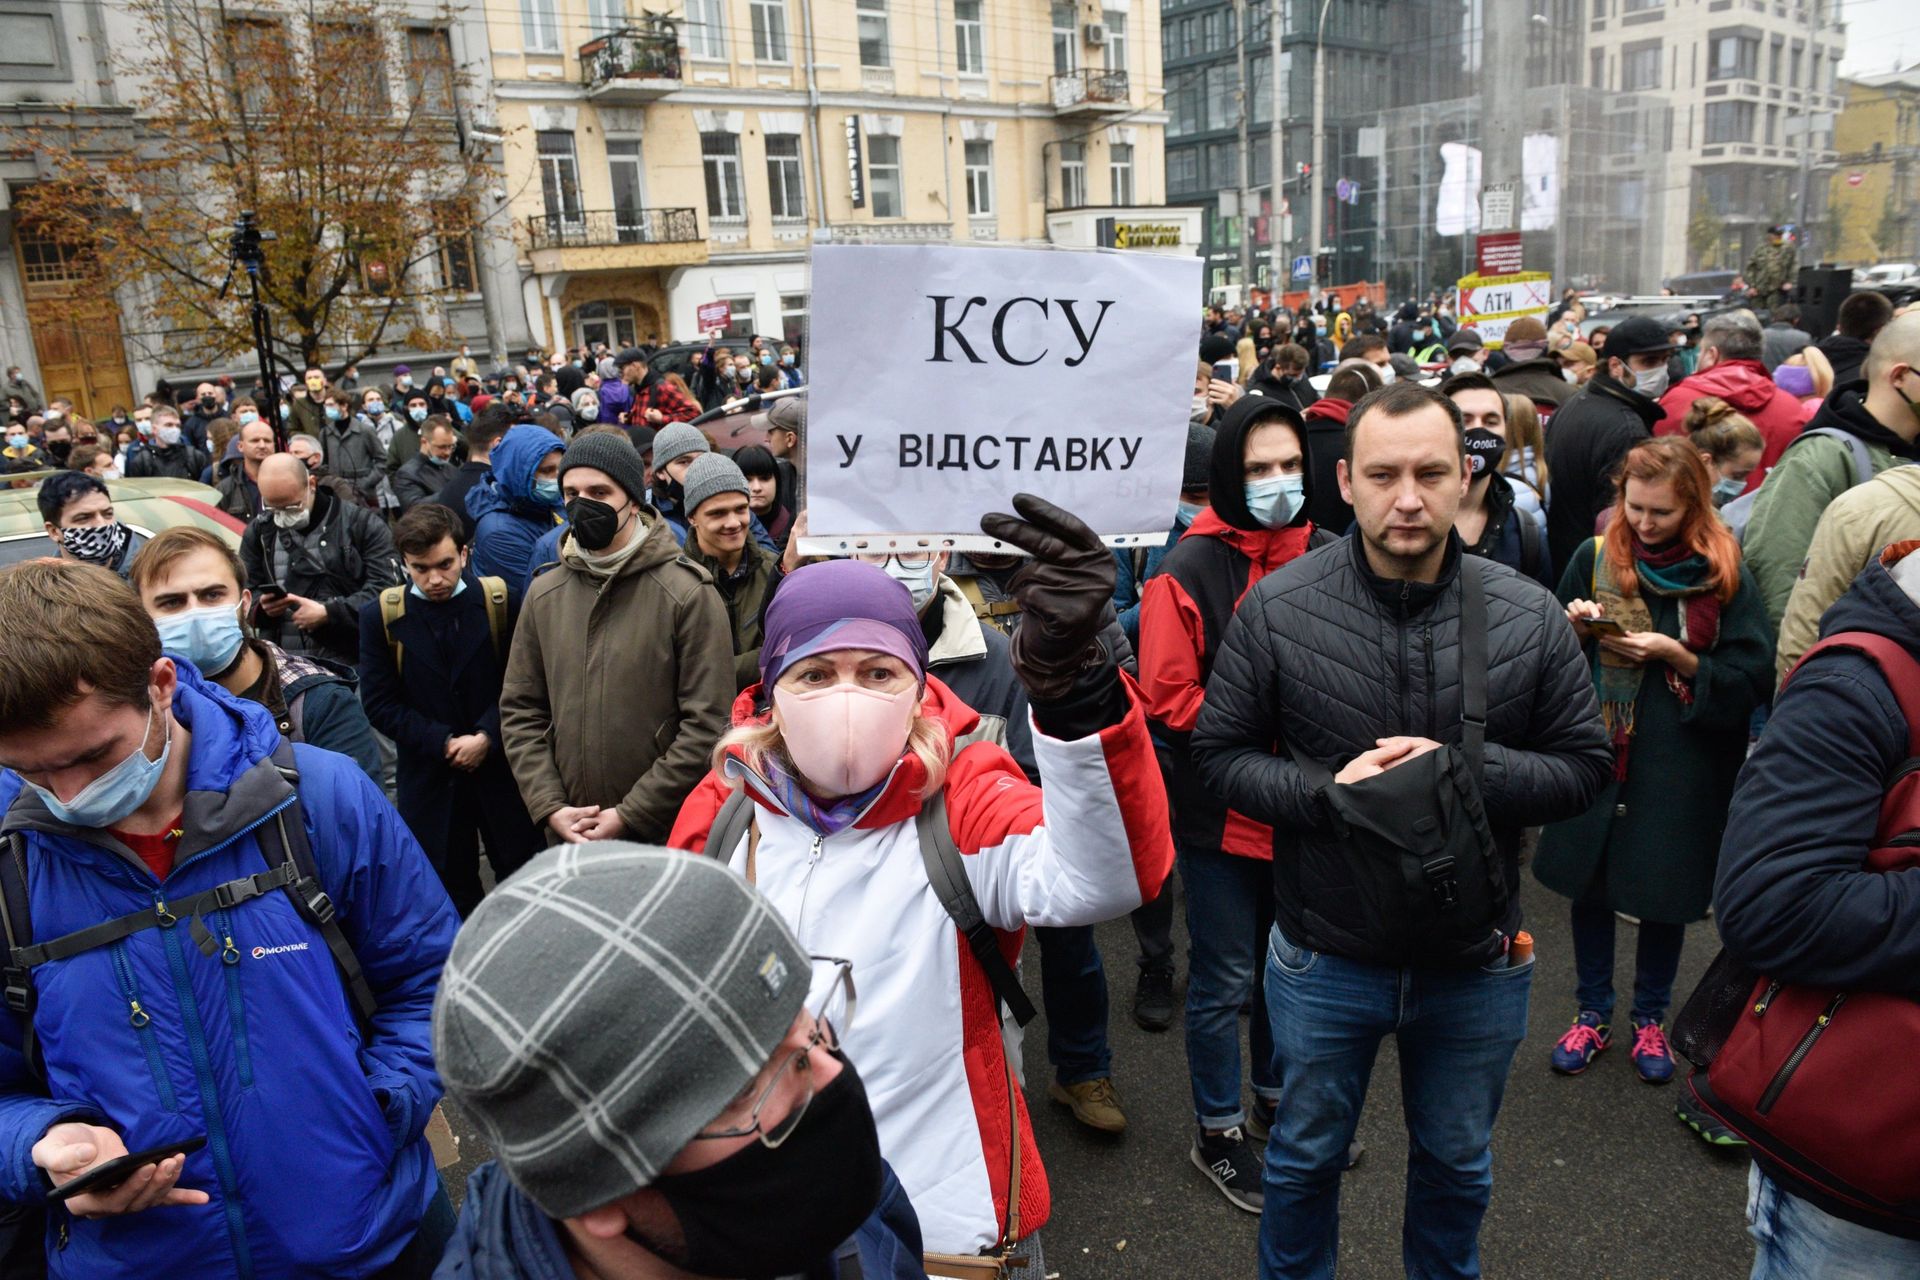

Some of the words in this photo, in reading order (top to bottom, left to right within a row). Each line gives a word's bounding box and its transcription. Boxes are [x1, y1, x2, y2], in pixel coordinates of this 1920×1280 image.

[925, 295, 1116, 367] КСУ
[836, 434, 863, 468] У
[900, 433, 1143, 471] ВІДСТАВКУ
